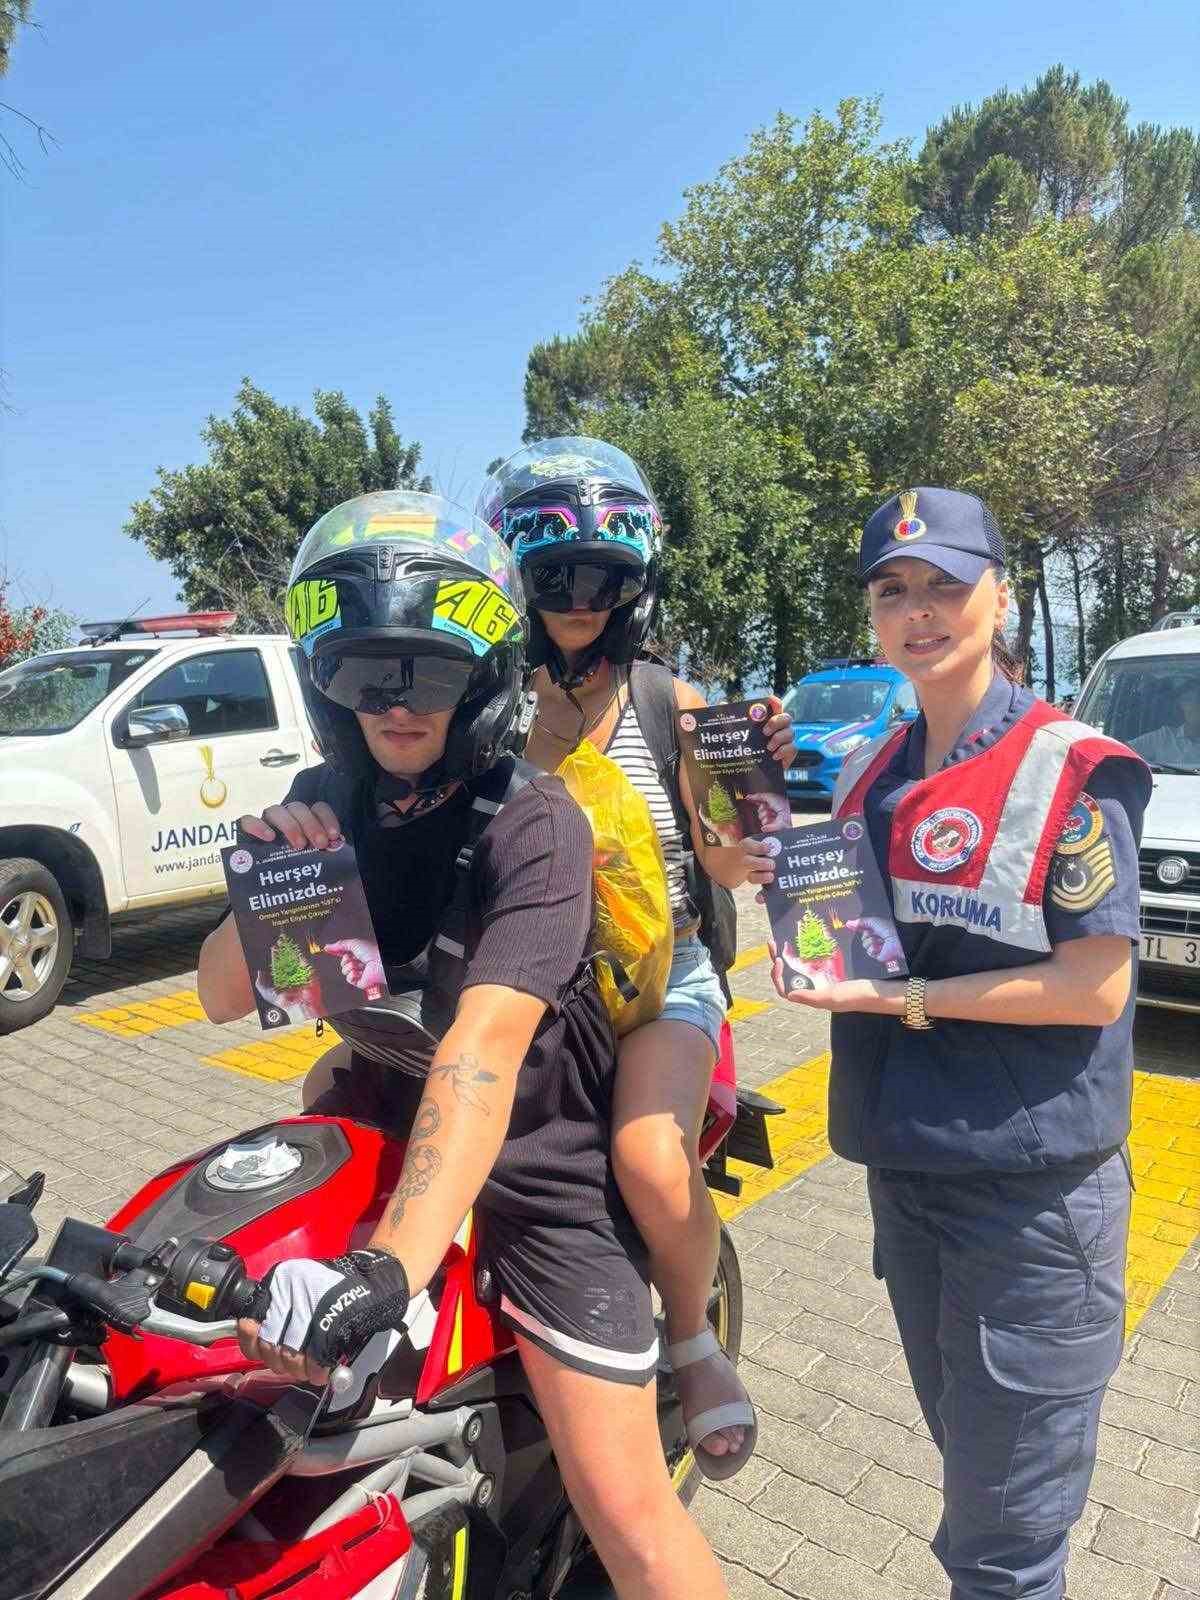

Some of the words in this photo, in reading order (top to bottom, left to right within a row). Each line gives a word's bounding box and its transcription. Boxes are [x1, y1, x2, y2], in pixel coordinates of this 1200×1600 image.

[700, 728, 750, 744] Herşey
[787, 848, 844, 869] Herşey
[259, 861, 323, 887] Herşey
[777, 866, 864, 890] Elimizde...
[248, 882, 344, 912] Elimizde...
[911, 891, 1002, 932] KORUMA
[1143, 936, 1168, 961] TL
[320, 1284, 371, 1332] TRAZANO
